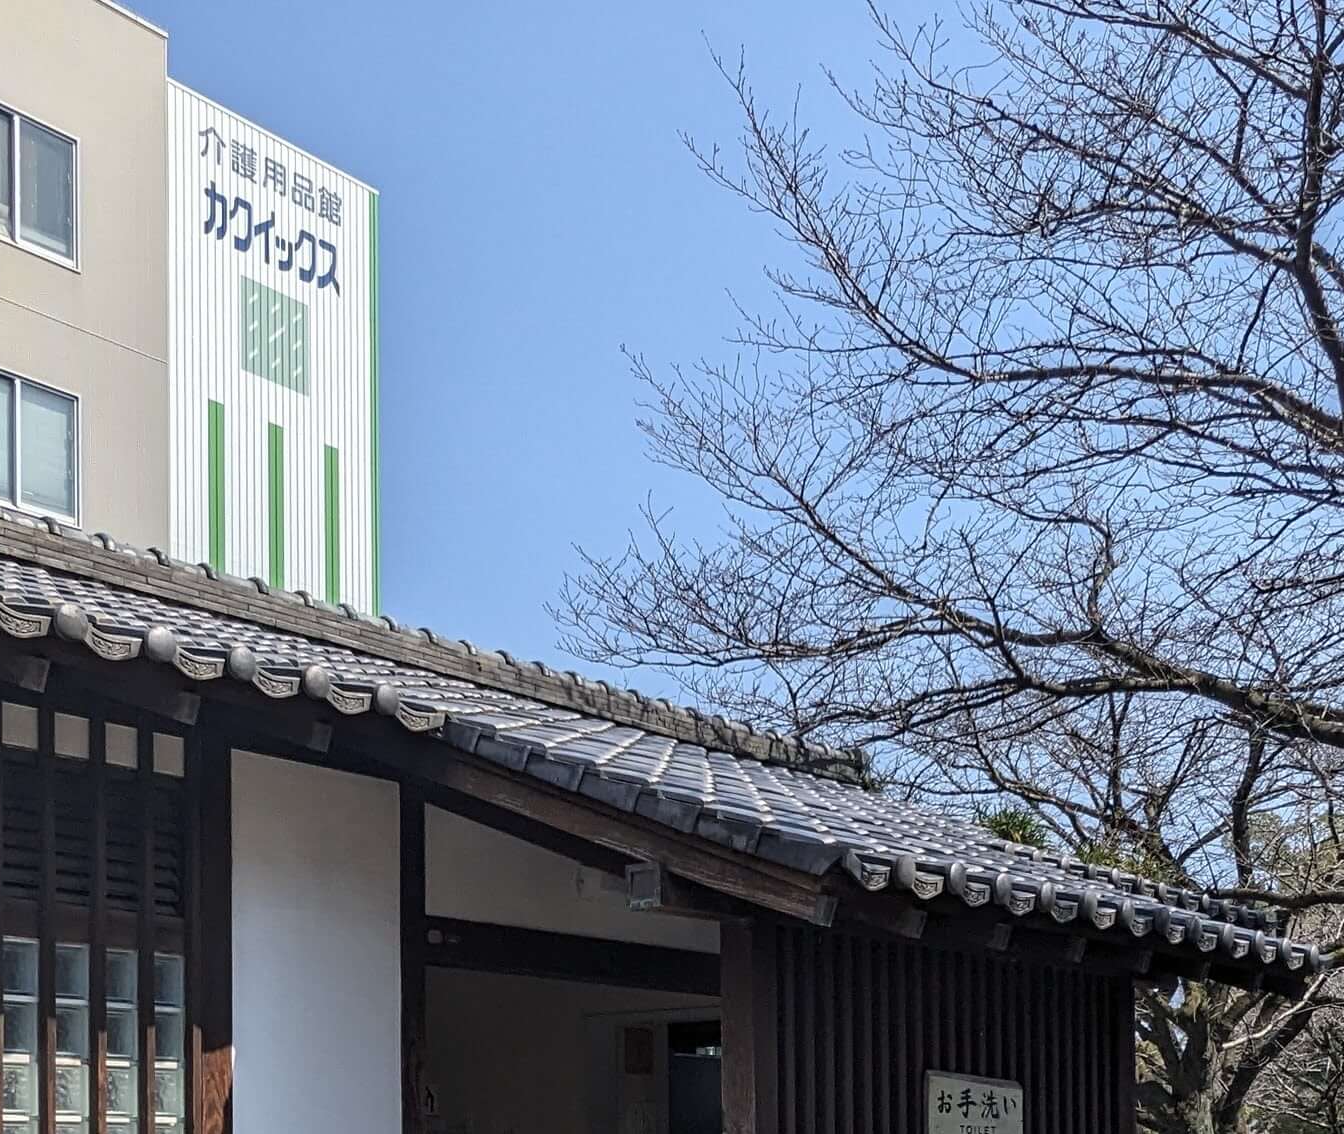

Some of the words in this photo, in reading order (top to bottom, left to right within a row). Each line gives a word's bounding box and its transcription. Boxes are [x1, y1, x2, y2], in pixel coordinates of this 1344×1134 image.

[198, 126, 343, 227] 介護用品館
[203, 180, 341, 297] カクイックス
[937, 1088, 1016, 1119] お手洗い
[959, 1124, 997, 1134] TOILET
